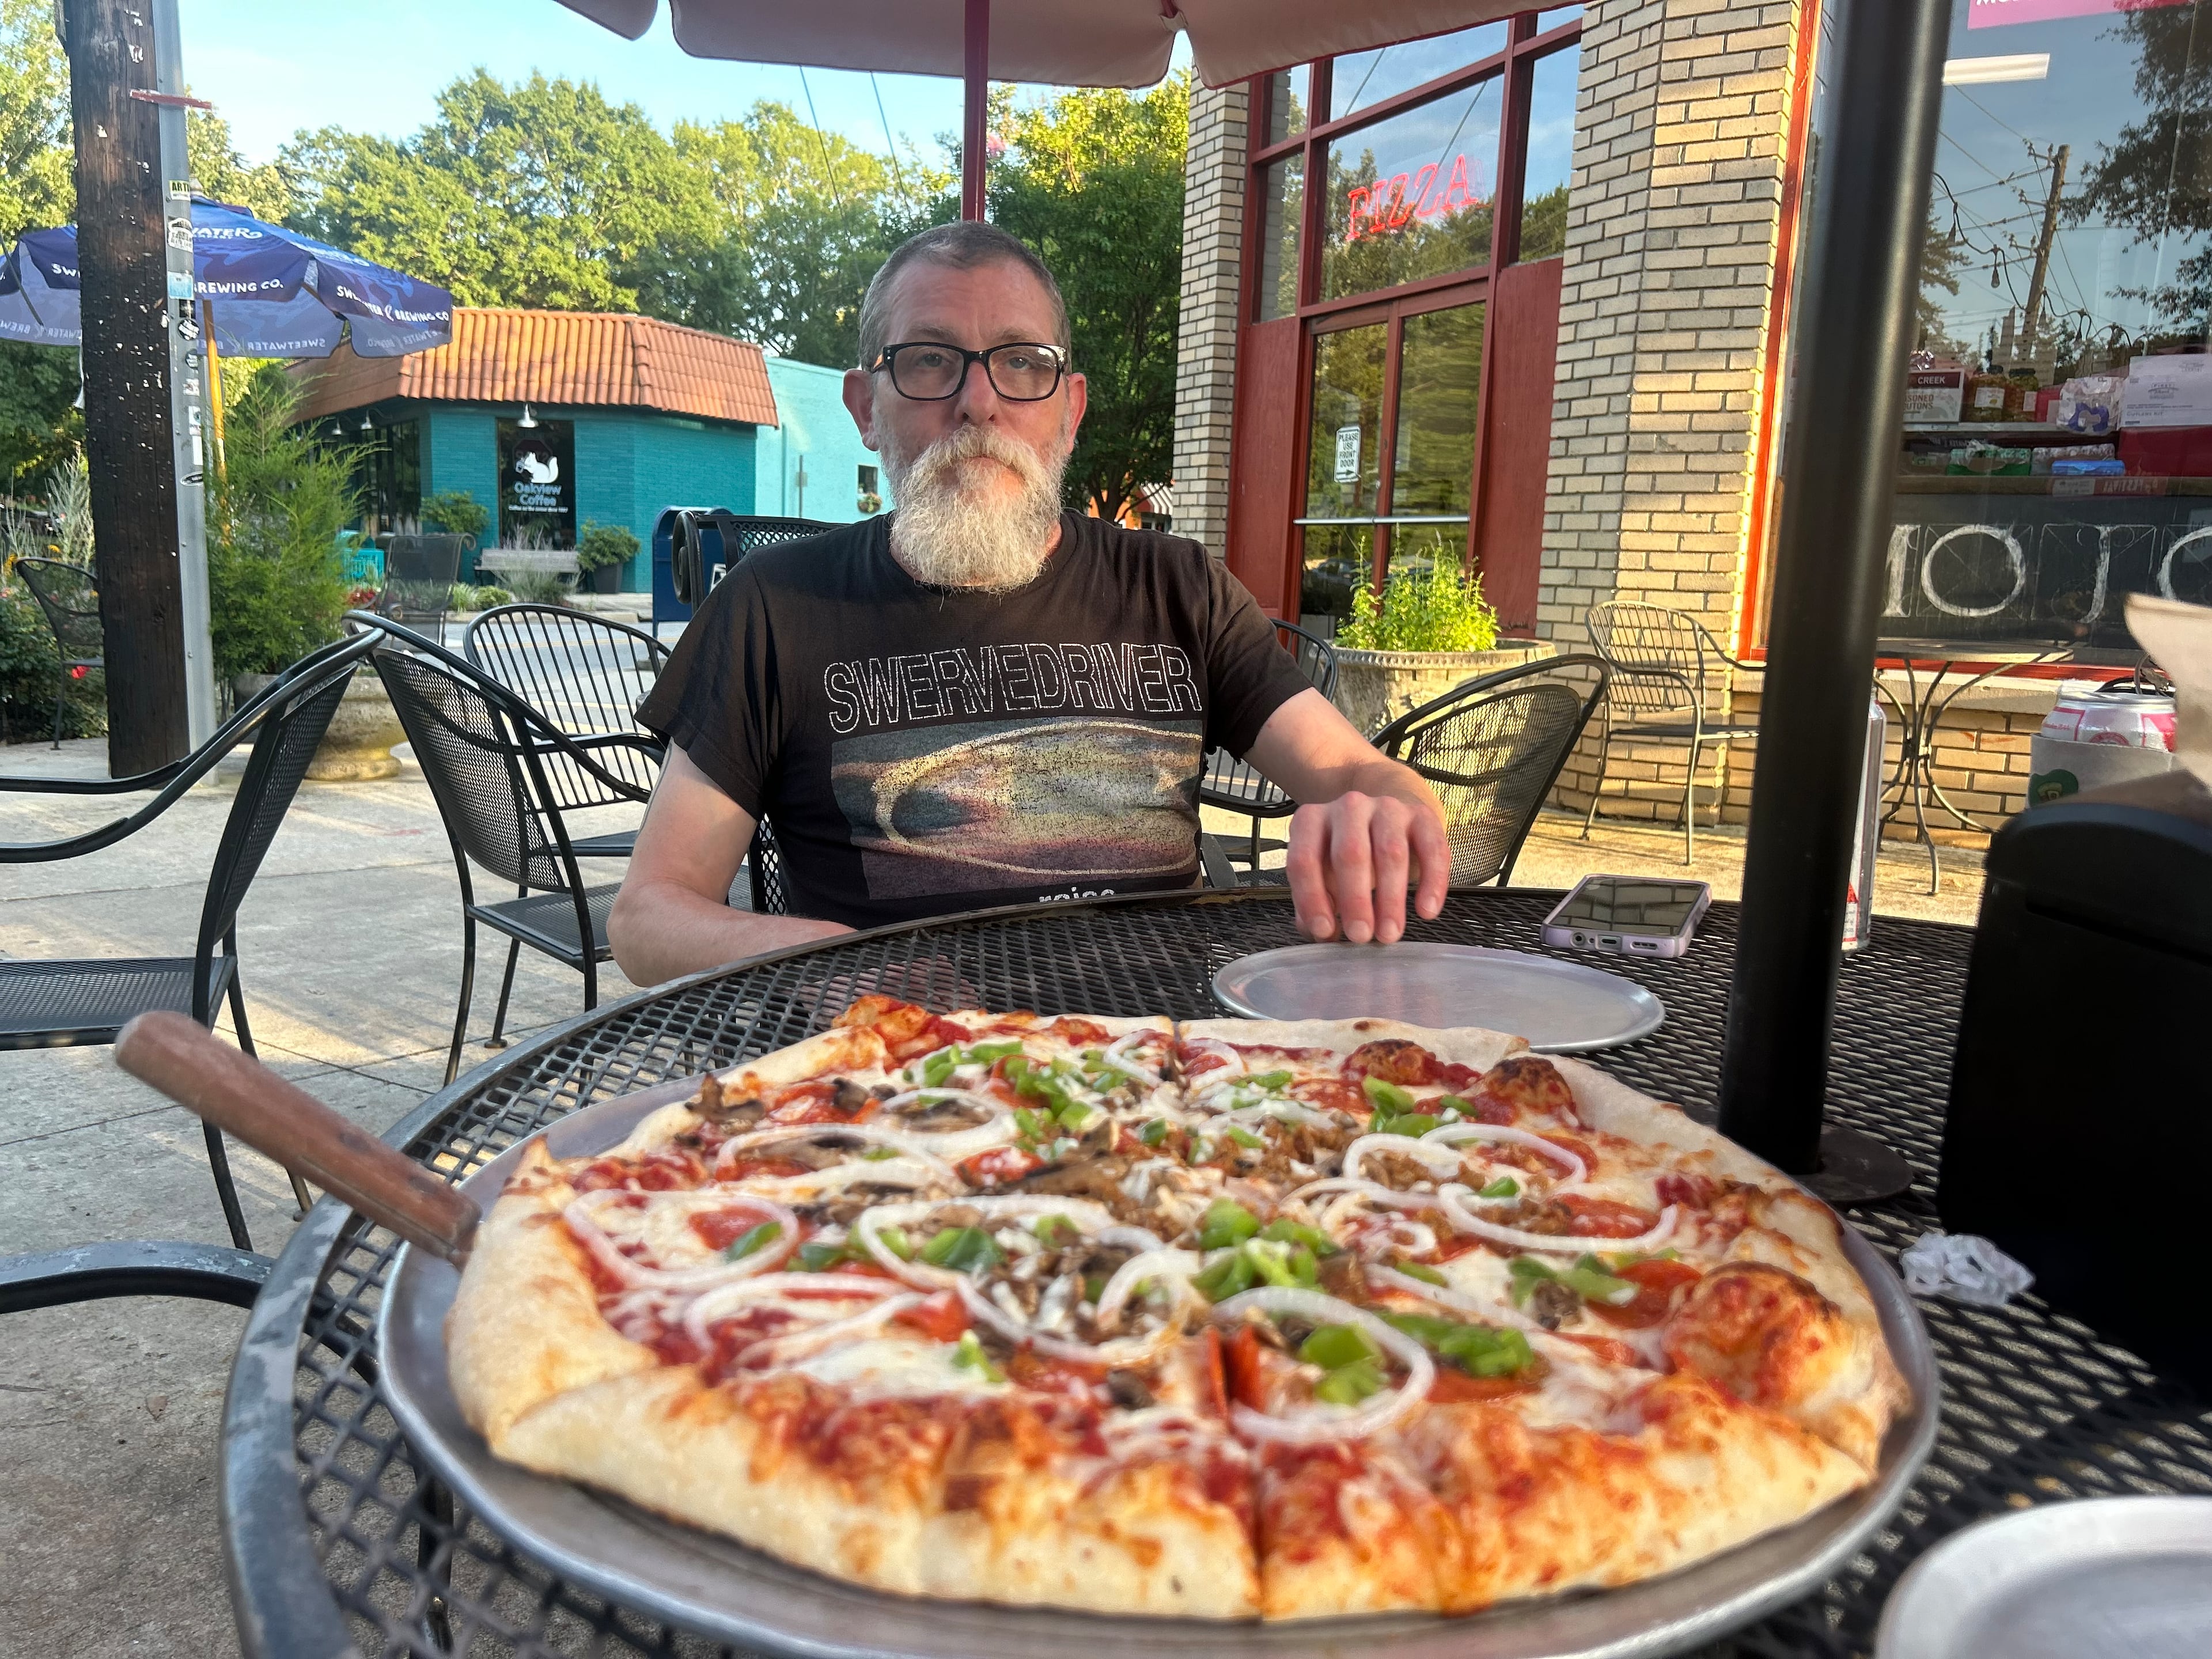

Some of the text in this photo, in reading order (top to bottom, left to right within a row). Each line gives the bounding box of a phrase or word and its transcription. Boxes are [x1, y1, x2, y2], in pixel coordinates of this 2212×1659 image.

[1345, 153, 1479, 241] PIZZA
[1917, 376, 1945, 385] CREEK
[1339, 432, 1359, 442] PLEASE
[1343, 441, 1354, 450] USE
[1339, 450, 1356, 459] FRONT
[1340, 459, 1355, 468] DOOR
[514, 481, 562, 495] Oakview
[520, 494, 557, 507] Coffee
[823, 642, 1203, 734] SWERVEDRIVER
